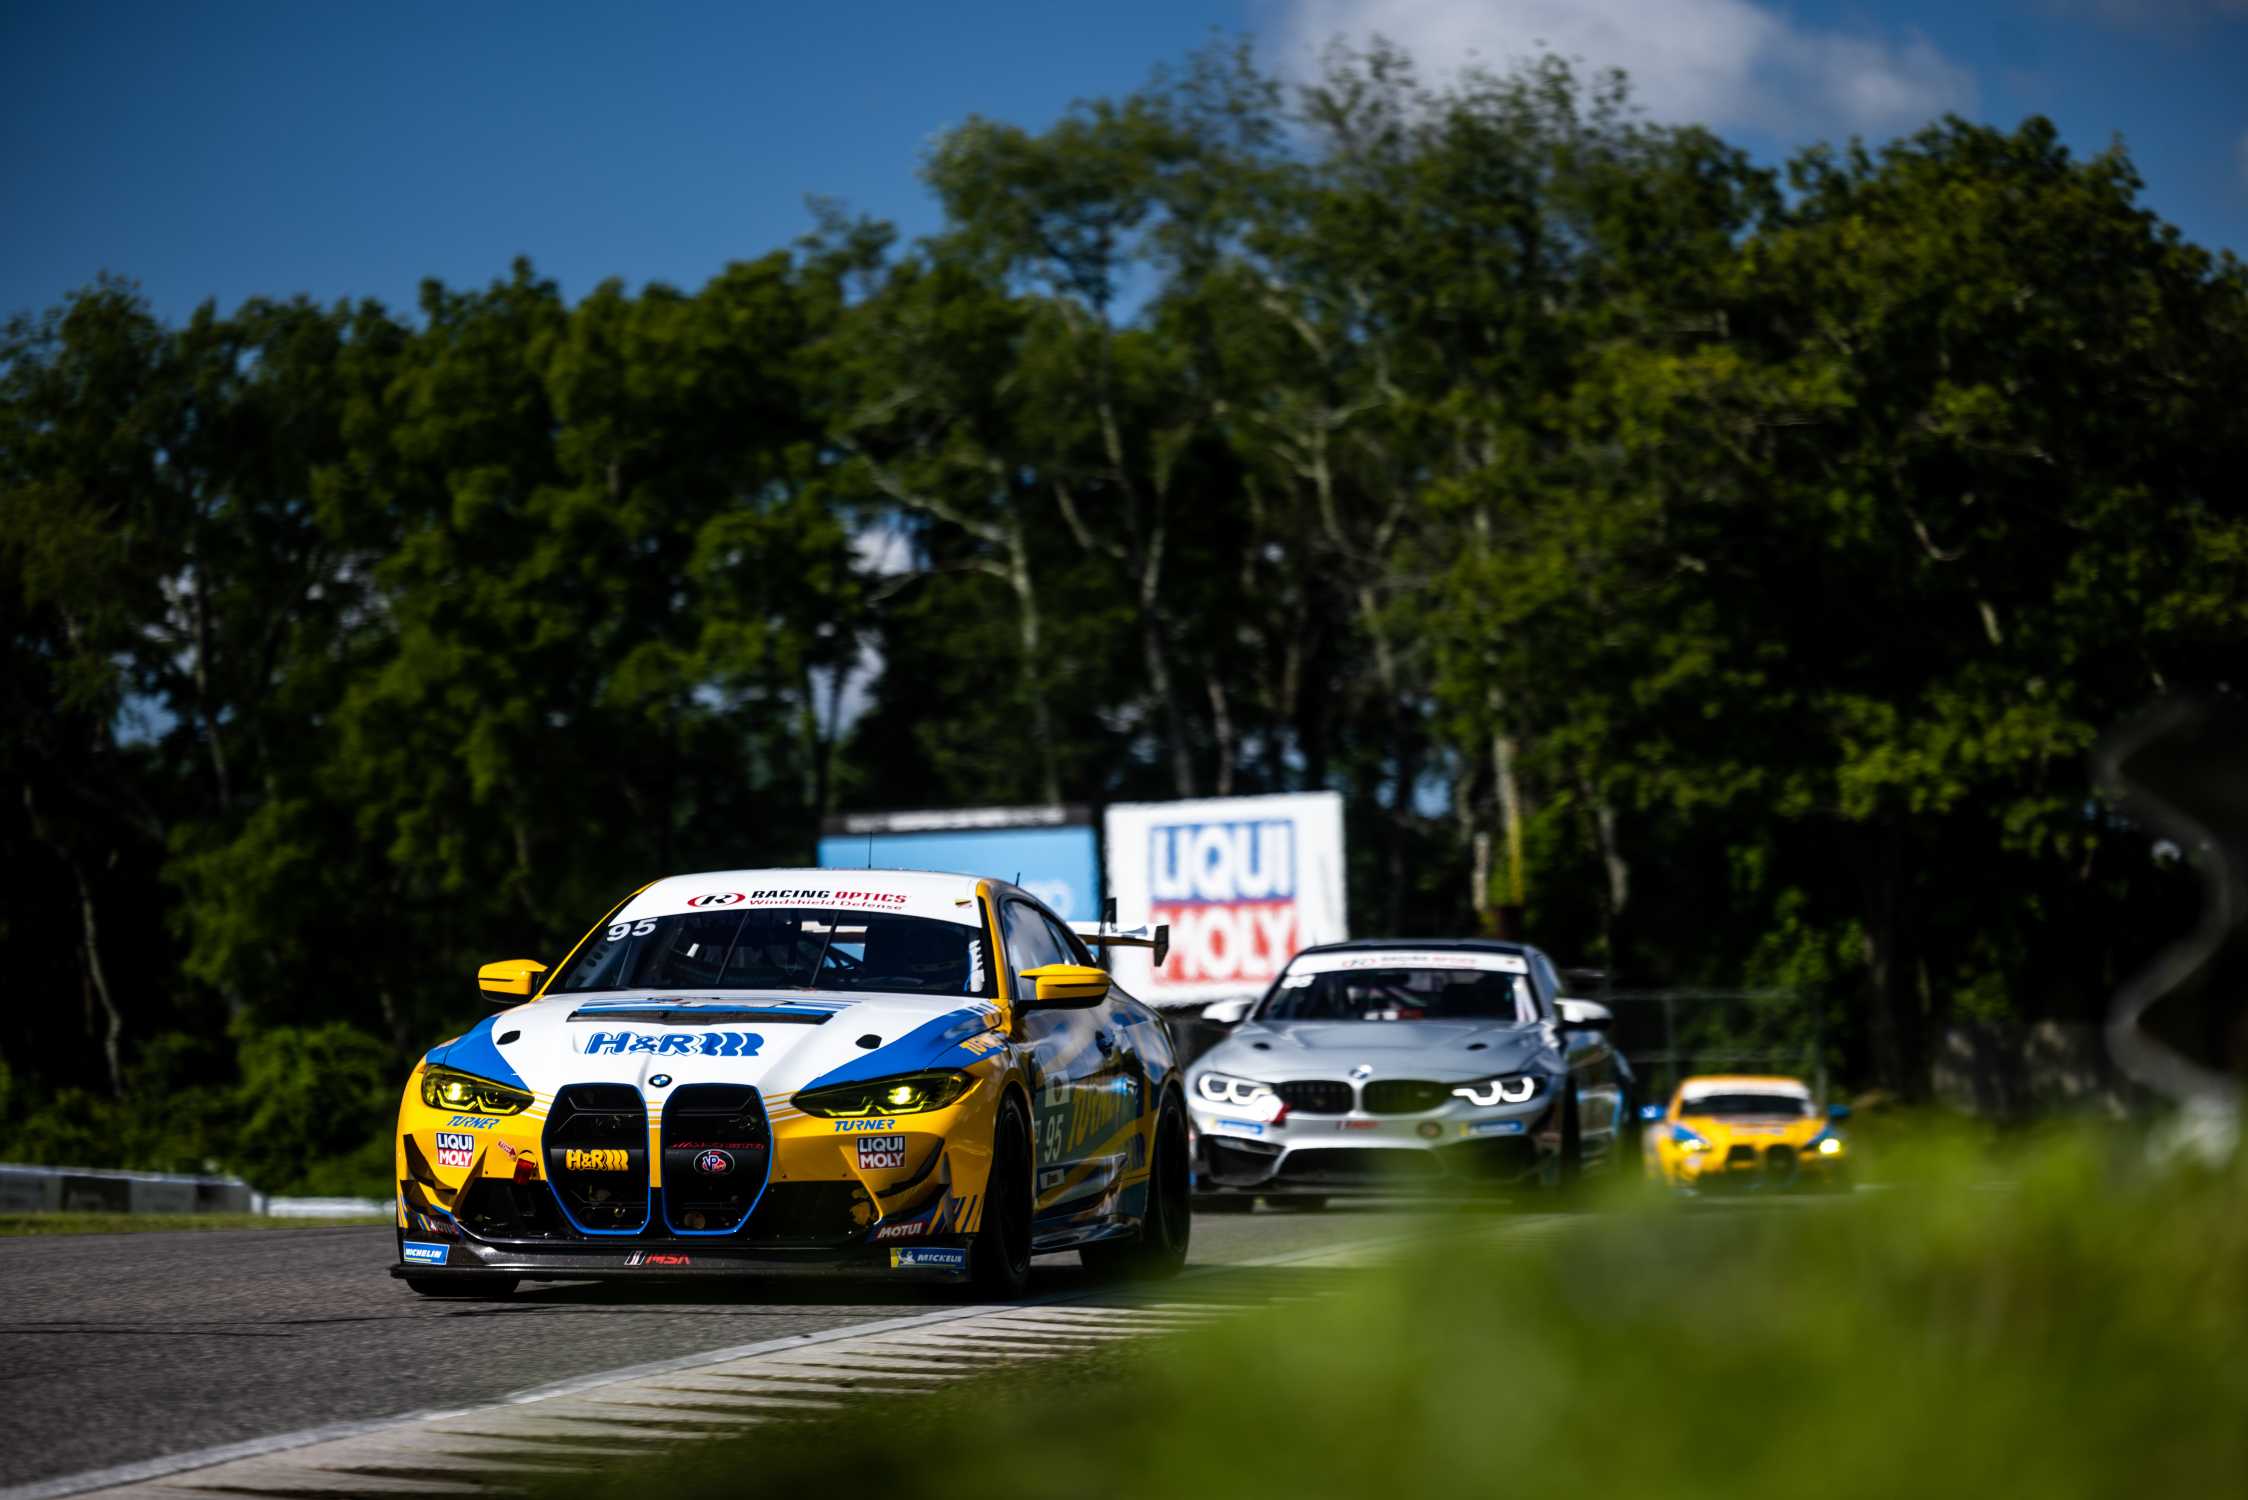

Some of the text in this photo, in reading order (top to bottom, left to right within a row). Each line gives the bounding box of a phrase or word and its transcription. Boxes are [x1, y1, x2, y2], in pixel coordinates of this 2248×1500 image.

[1152, 826, 1293, 899] LIQUI
[751, 889, 830, 899] RACING
[835, 891, 908, 904] OPTICS
[840, 900, 903, 911] Defense
[607, 917, 658, 942] 95
[1153, 905, 1297, 981] MOLY
[447, 1115, 501, 1130] TURNER
[834, 1119, 896, 1132] TURNER
[437, 1133, 473, 1151] LIQUI
[859, 1136, 904, 1153] LIQUI
[1044, 1114, 1065, 1163] 95
[439, 1150, 473, 1167] MOLY
[860, 1152, 905, 1169] MOLY
